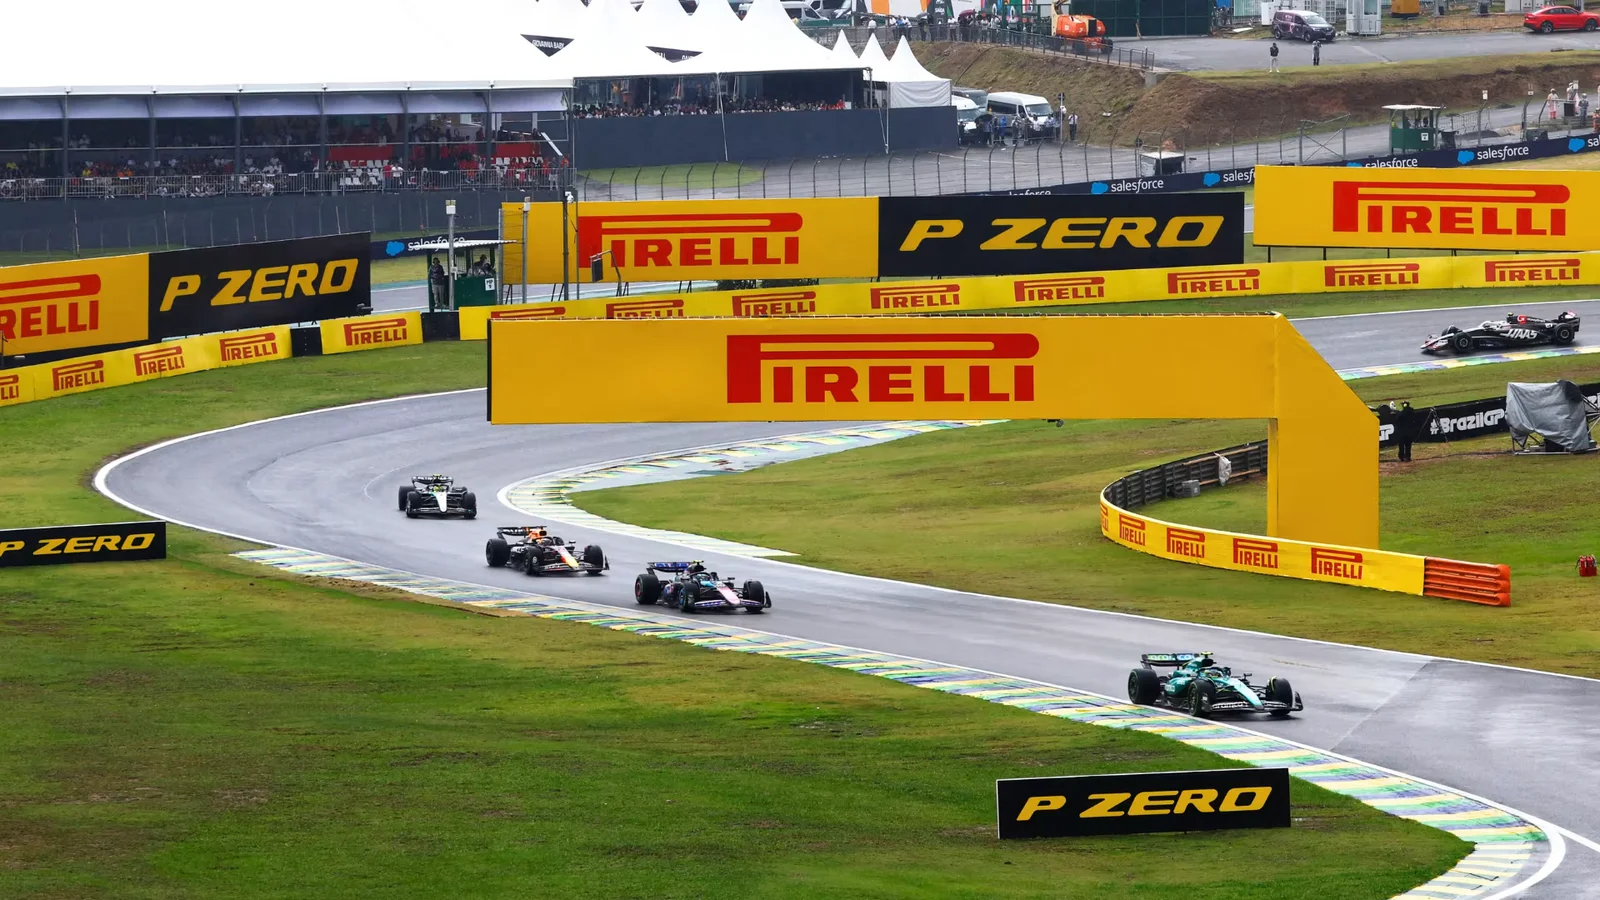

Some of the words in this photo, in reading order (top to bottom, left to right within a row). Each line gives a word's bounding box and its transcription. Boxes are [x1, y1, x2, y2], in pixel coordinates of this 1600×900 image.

[1477, 144, 1529, 162] salesforce
[1110, 178, 1164, 194] salesforce
[1333, 181, 1571, 237] PIRELLI
[576, 212, 804, 269] PIRELLI
[899, 219, 961, 252] P
[979, 215, 1225, 251] ZERO
[159, 274, 201, 312] P
[210, 258, 359, 307] ZERO
[1168, 269, 1260, 294] PIRELLI
[1325, 263, 1420, 287] PIRELLI
[1486, 259, 1580, 282] PIRELLI
[871, 284, 960, 309] PIRELLI
[1015, 276, 1105, 302] PIRELLI
[732, 291, 816, 318] PIRELLI
[220, 332, 278, 361] PIRELLI
[345, 318, 407, 346] PIRELLI
[1507, 328, 1538, 339] HAAS
[52, 359, 105, 392] PIRELLI
[134, 346, 185, 377] PIRELLI
[727, 333, 1040, 404] PIRELLI
[1429, 408, 1505, 435] #BrazilGP
[1119, 513, 1146, 546] PIRELLI
[1166, 527, 1206, 558] PIRELLI
[0, 540, 25, 557] P
[33, 533, 156, 556] ZERO
[1233, 537, 1279, 570] PIRELLI
[1311, 547, 1363, 580] PIRELLI
[1016, 795, 1067, 821] P
[1079, 786, 1273, 818] ZERO
